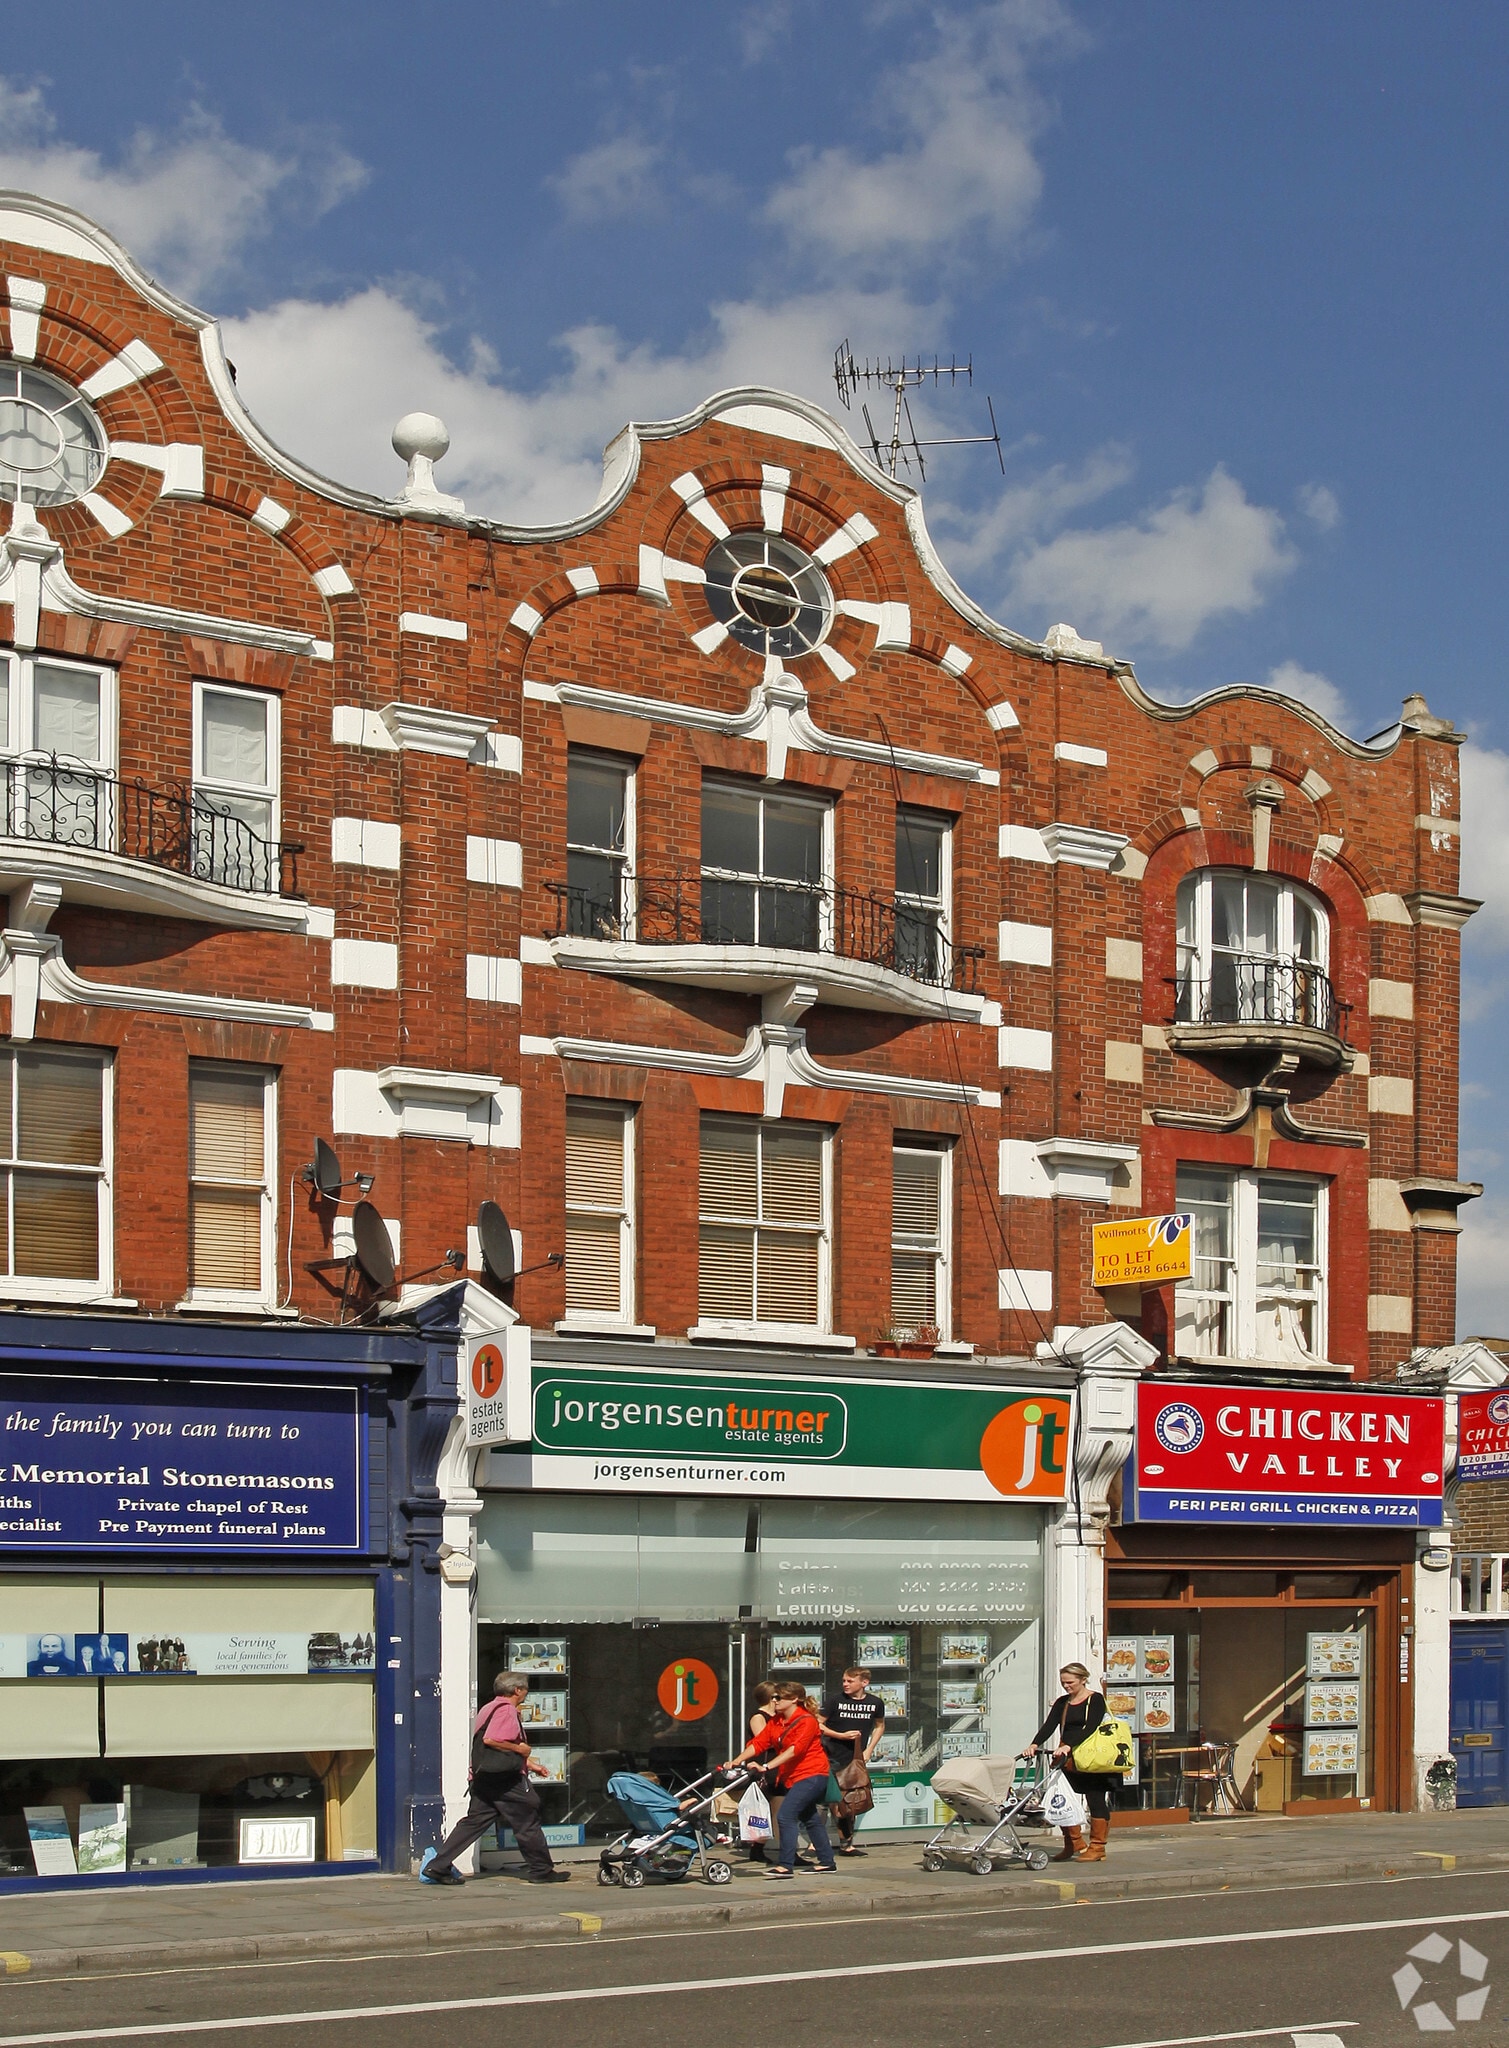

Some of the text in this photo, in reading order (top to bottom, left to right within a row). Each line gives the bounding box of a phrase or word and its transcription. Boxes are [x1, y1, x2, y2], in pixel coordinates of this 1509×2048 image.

[1098, 1227, 1146, 1239] Willmotts
[1098, 1249, 1155, 1267] TO LET
[1097, 1268, 1119, 1280] 020
[1124, 1264, 1151, 1277] 8748
[1156, 1261, 1187, 1273] 6644
[480, 1353, 494, 1393] jt
[472, 1400, 504, 1420] estate
[6, 1411, 300, 1441] the family you can turn to
[471, 1416, 506, 1439] agents
[1216, 1405, 1411, 1445] CHICKEN
[1465, 1426, 1509, 1442] CHIC
[725, 1429, 824, 1446] estate agents
[1014, 1404, 1067, 1491] jt
[1226, 1452, 1403, 1479] VALLEY
[1462, 1454, 1487, 1464] 0208
[1463, 1463, 1494, 1472] PERI
[11, 1464, 150, 1486] Memorial
[162, 1468, 335, 1490] Stonemasons
[593, 1461, 786, 1482] jorgensenturner.com
[1461, 1470, 1481, 1478] GRILL
[117, 1498, 181, 1512] Private
[186, 1499, 242, 1517] chapel
[247, 1501, 268, 1514] of
[271, 1501, 309, 1515] Rest
[1168, 1499, 1418, 1517] PERI PERI GRILL CHICKEN & PIZZA
[99, 1519, 130, 1532] Pre
[136, 1520, 213, 1537] Payment
[218, 1521, 278, 1535] funeral
[283, 1522, 326, 1538] plans
[228, 1636, 277, 1650] Serving
[216, 1651, 288, 1662] local families for
[213, 1661, 290, 1672] seven generations
[673, 1664, 700, 1716] jt
[838, 1702, 877, 1713] HOLLISTER
[839, 1711, 872, 1720] CHALLENGE
